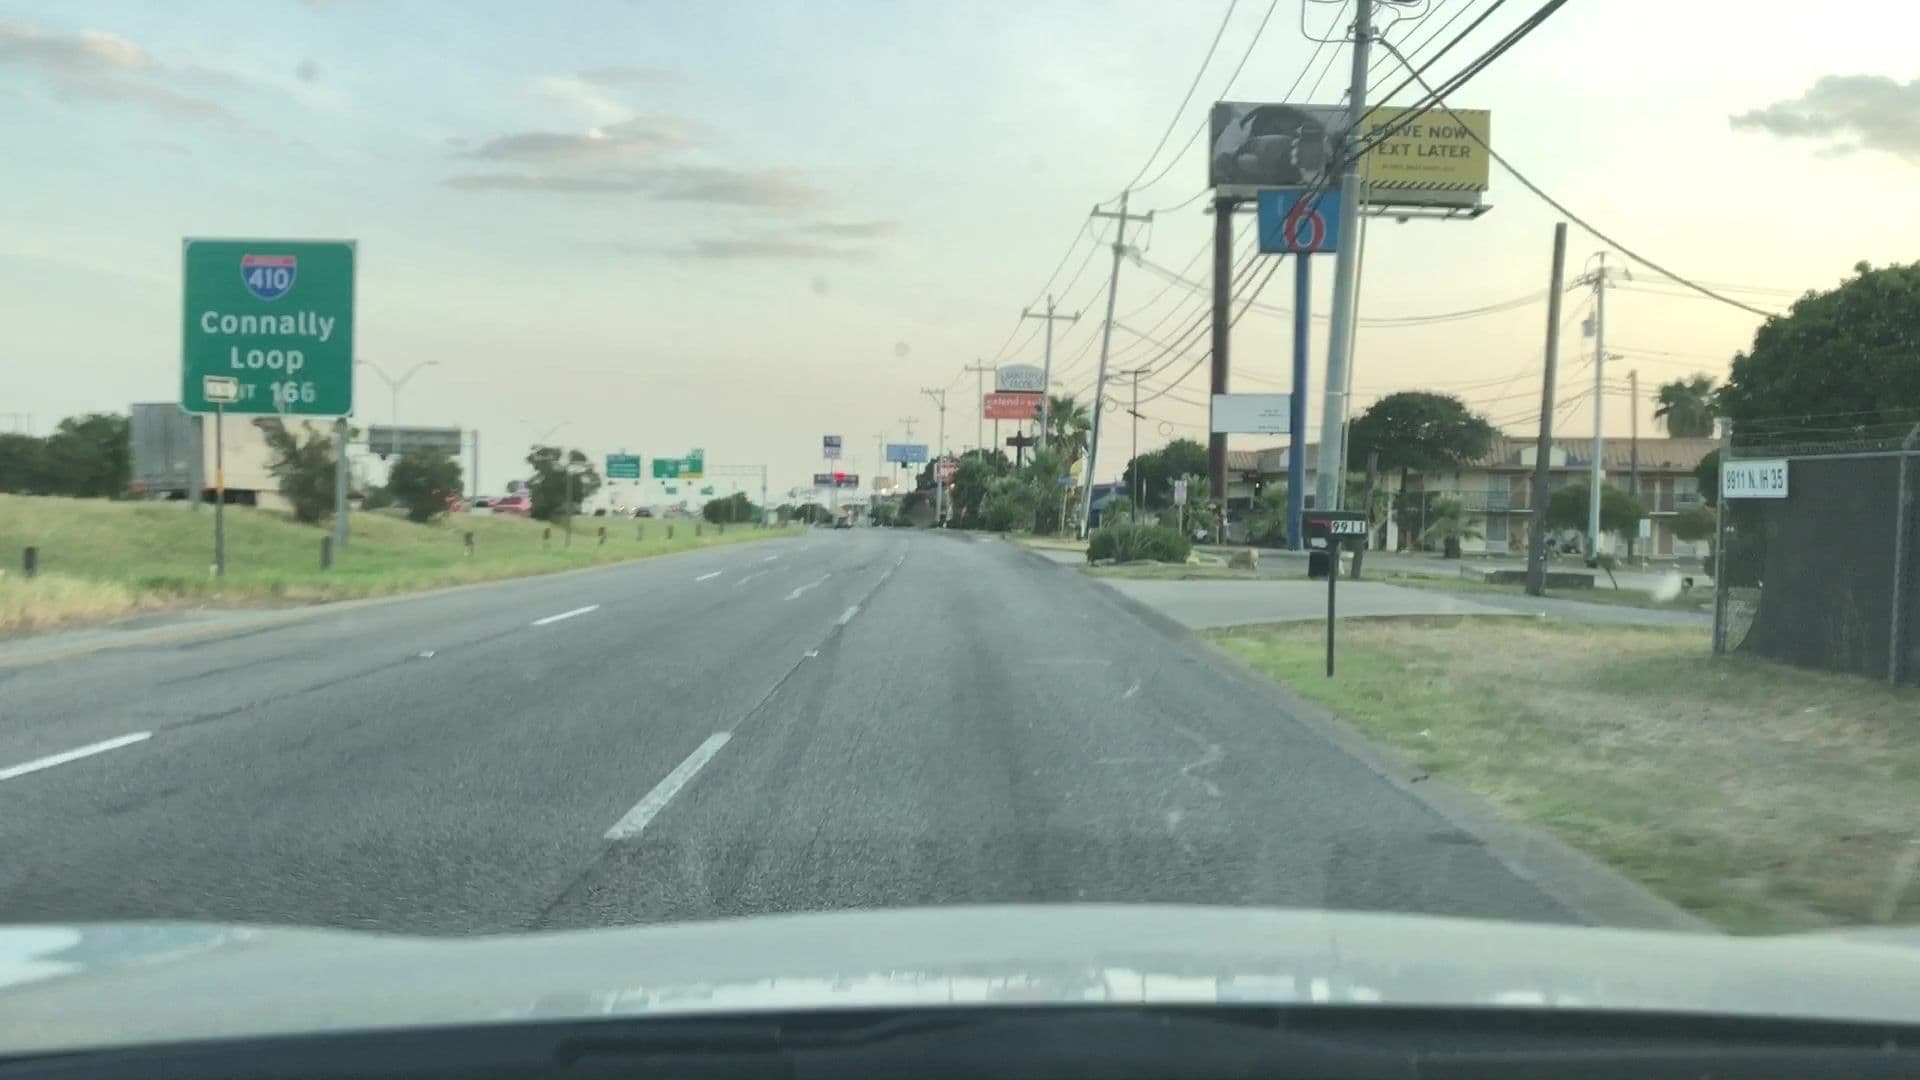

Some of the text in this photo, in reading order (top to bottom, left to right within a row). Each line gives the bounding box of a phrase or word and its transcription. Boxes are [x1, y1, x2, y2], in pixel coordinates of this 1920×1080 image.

[1429, 125, 1470, 139] NOW
[1417, 144, 1471, 158] LATER
[1283, 191, 1326, 252] 6
[250, 268, 289, 290] 410
[201, 310, 335, 342] Connally
[230, 345, 304, 375] Loop
[270, 380, 316, 403] 166
[1726, 470, 1745, 489] 9911
[1771, 468, 1784, 489] 35
[1333, 521, 1364, 533] 9911
